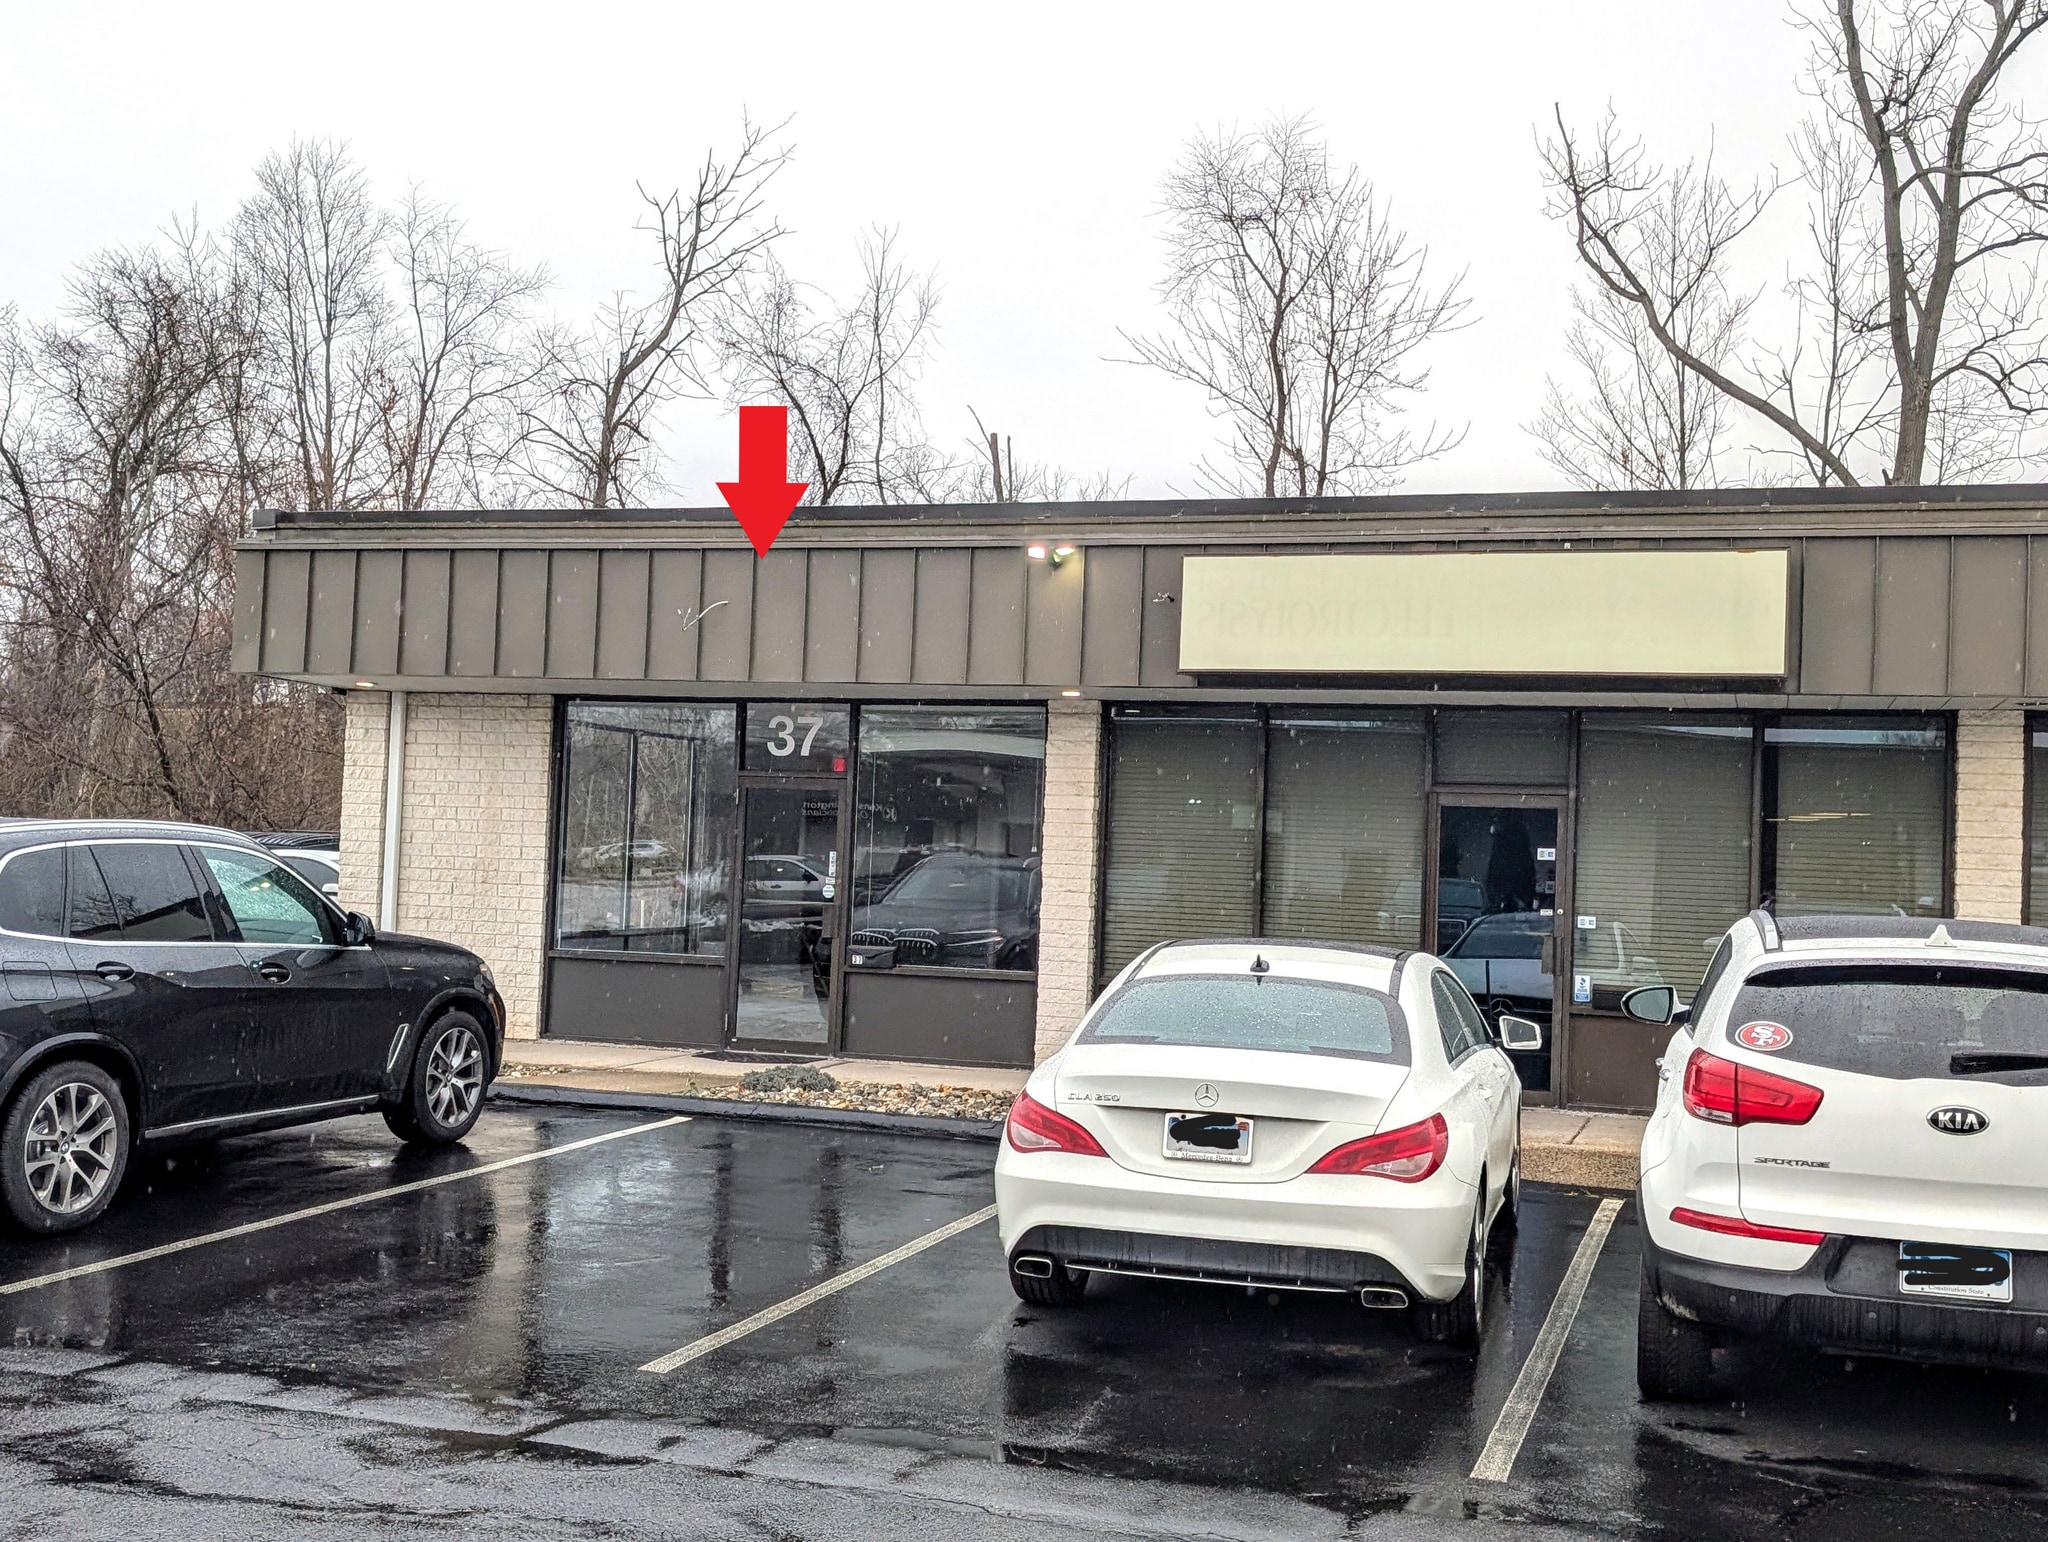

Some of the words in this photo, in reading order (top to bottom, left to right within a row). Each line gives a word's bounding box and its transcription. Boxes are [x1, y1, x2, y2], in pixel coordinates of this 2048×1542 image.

[767, 715, 824, 757] 37
[1750, 1025, 1782, 1046] SF
[1067, 1092, 1093, 1101] CLA
[1094, 1093, 1121, 1102] 250
[1938, 1111, 1980, 1131] KIA
[1753, 1156, 1831, 1169] SPORTAGE
